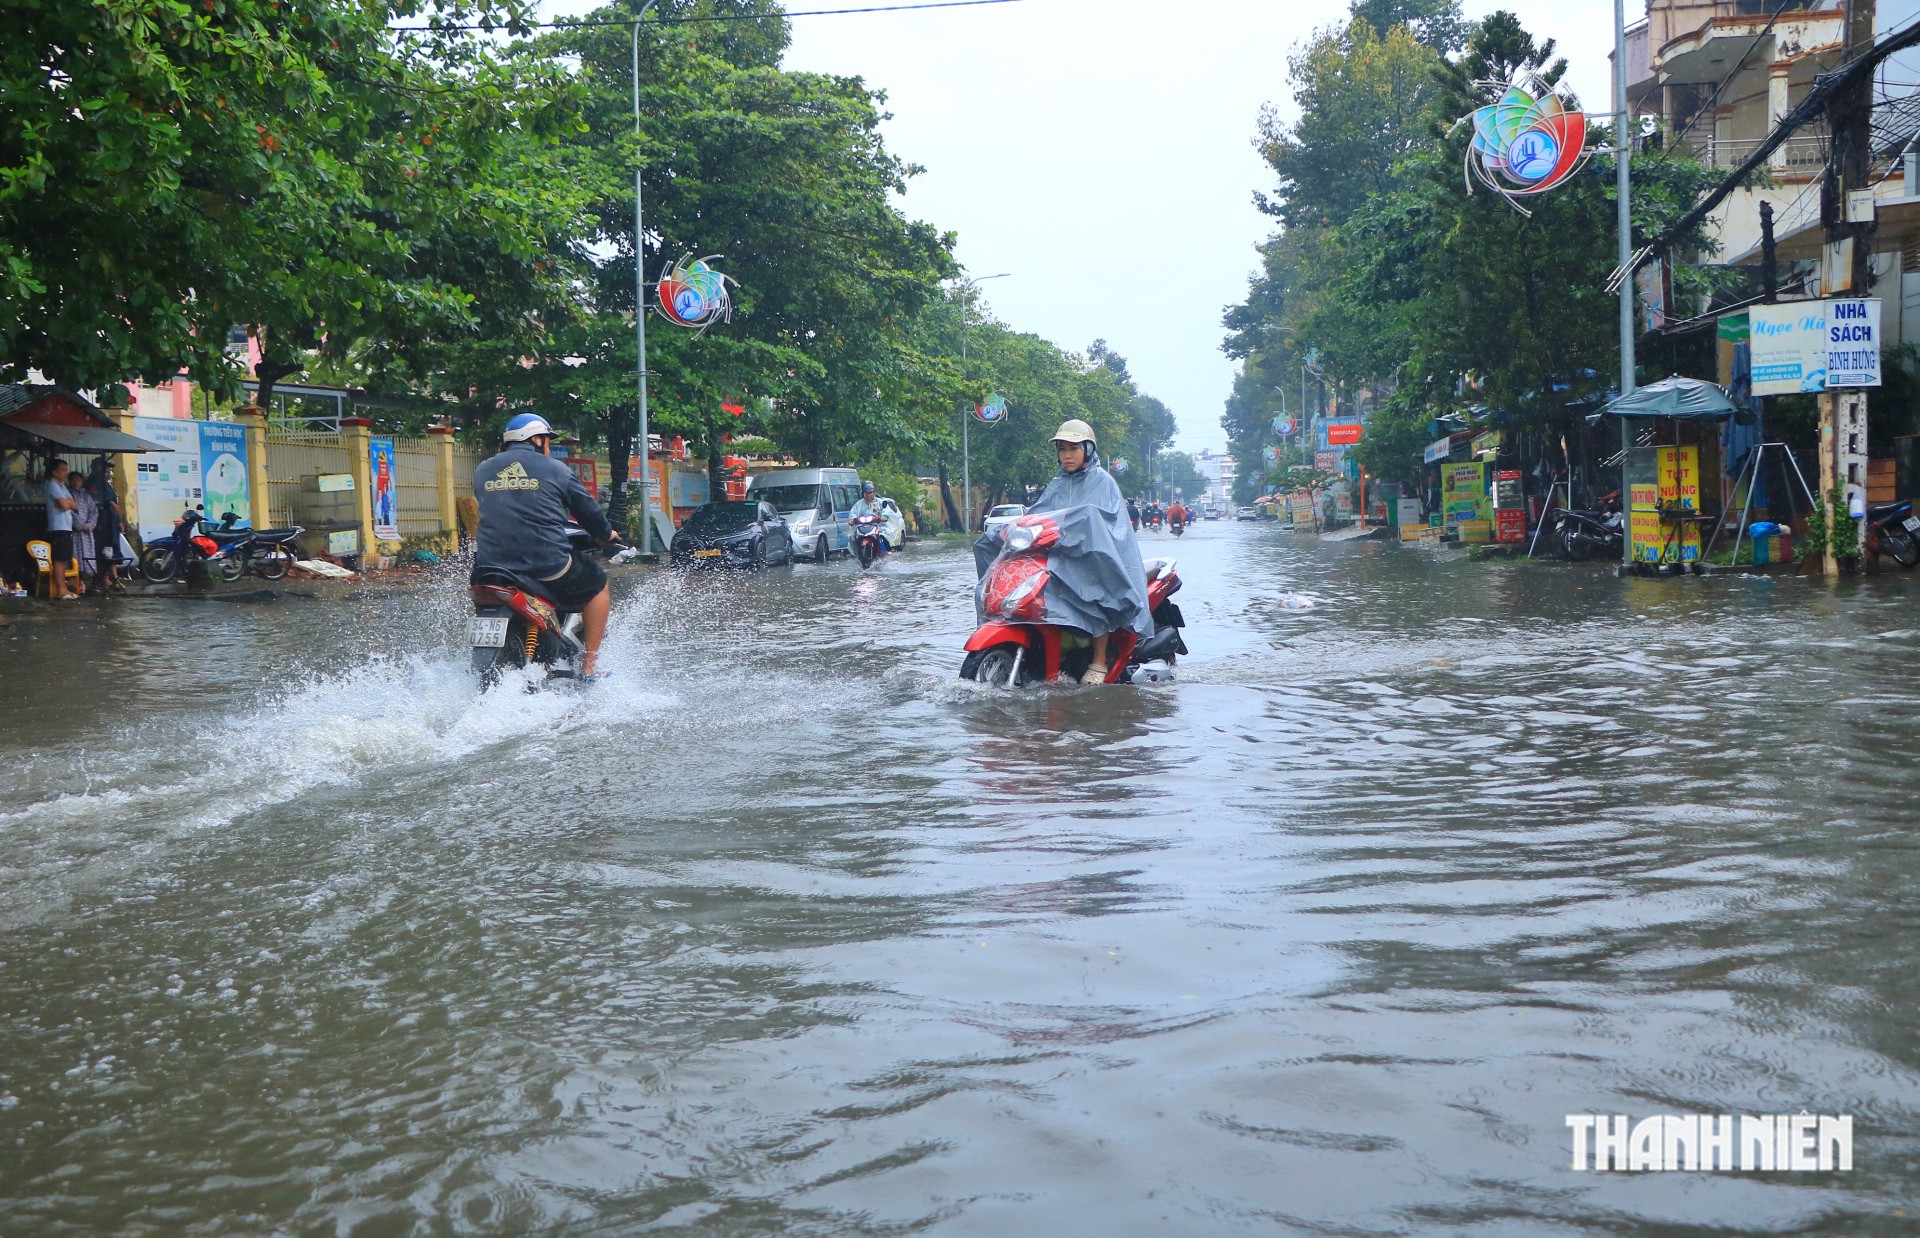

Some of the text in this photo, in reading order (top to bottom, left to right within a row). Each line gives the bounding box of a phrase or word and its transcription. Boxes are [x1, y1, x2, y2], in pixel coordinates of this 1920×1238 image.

[1834, 300, 1867, 320] NHÀ
[1830, 323, 1872, 343] SÁCH
[1828, 346, 1876, 370] BÌNH HƯNG
[484, 476, 540, 492] adidas
[472, 618, 502, 631] 54-N6
[469, 632, 500, 645] 0755
